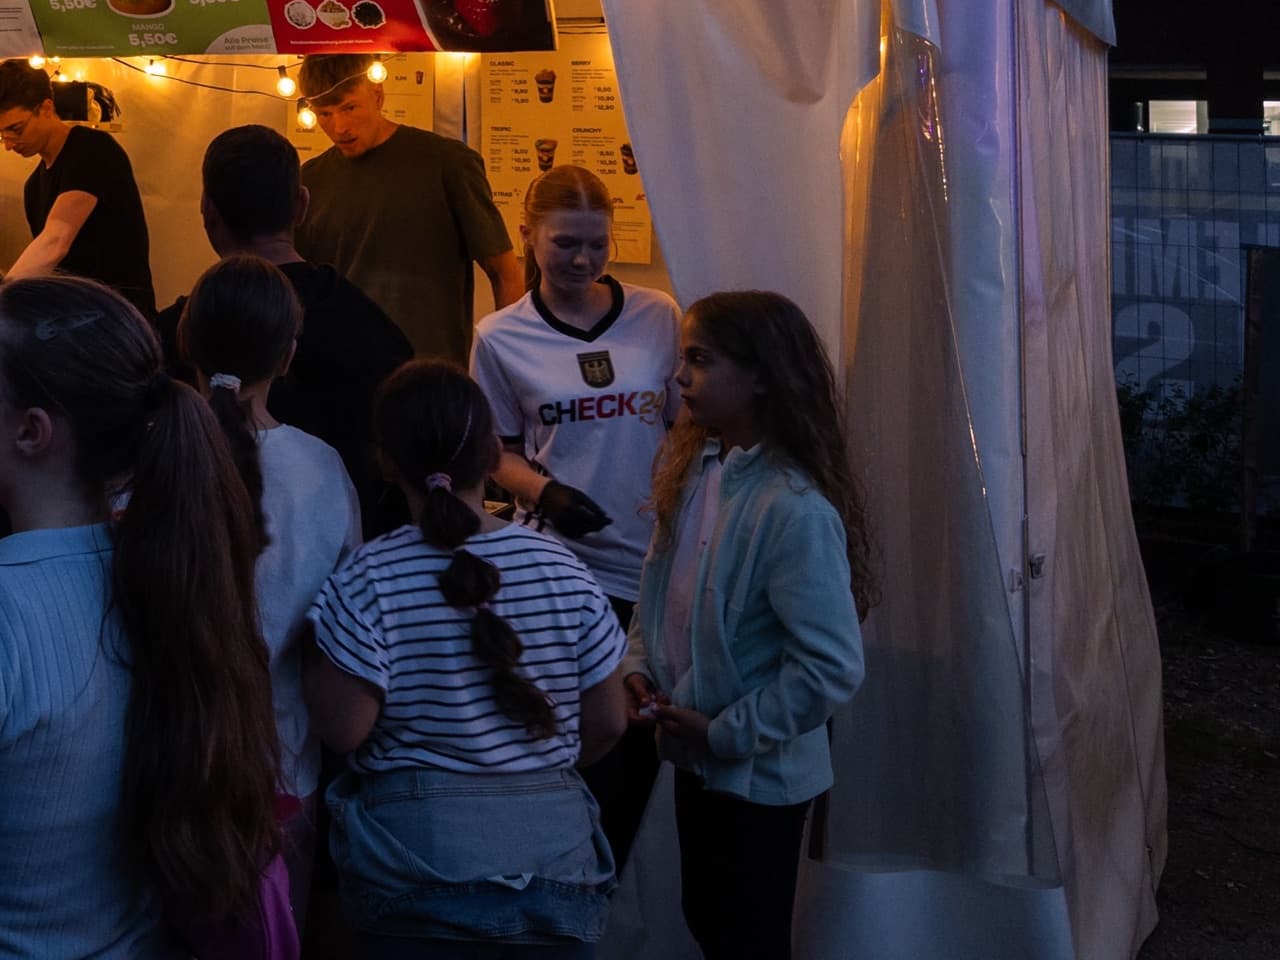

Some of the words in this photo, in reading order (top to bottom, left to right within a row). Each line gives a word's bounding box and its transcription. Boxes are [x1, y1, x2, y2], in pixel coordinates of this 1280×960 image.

[132, 22, 164, 32] MANGO
[128, 31, 178, 46] 5,50€
[538, 390, 666, 427] CHECK24
